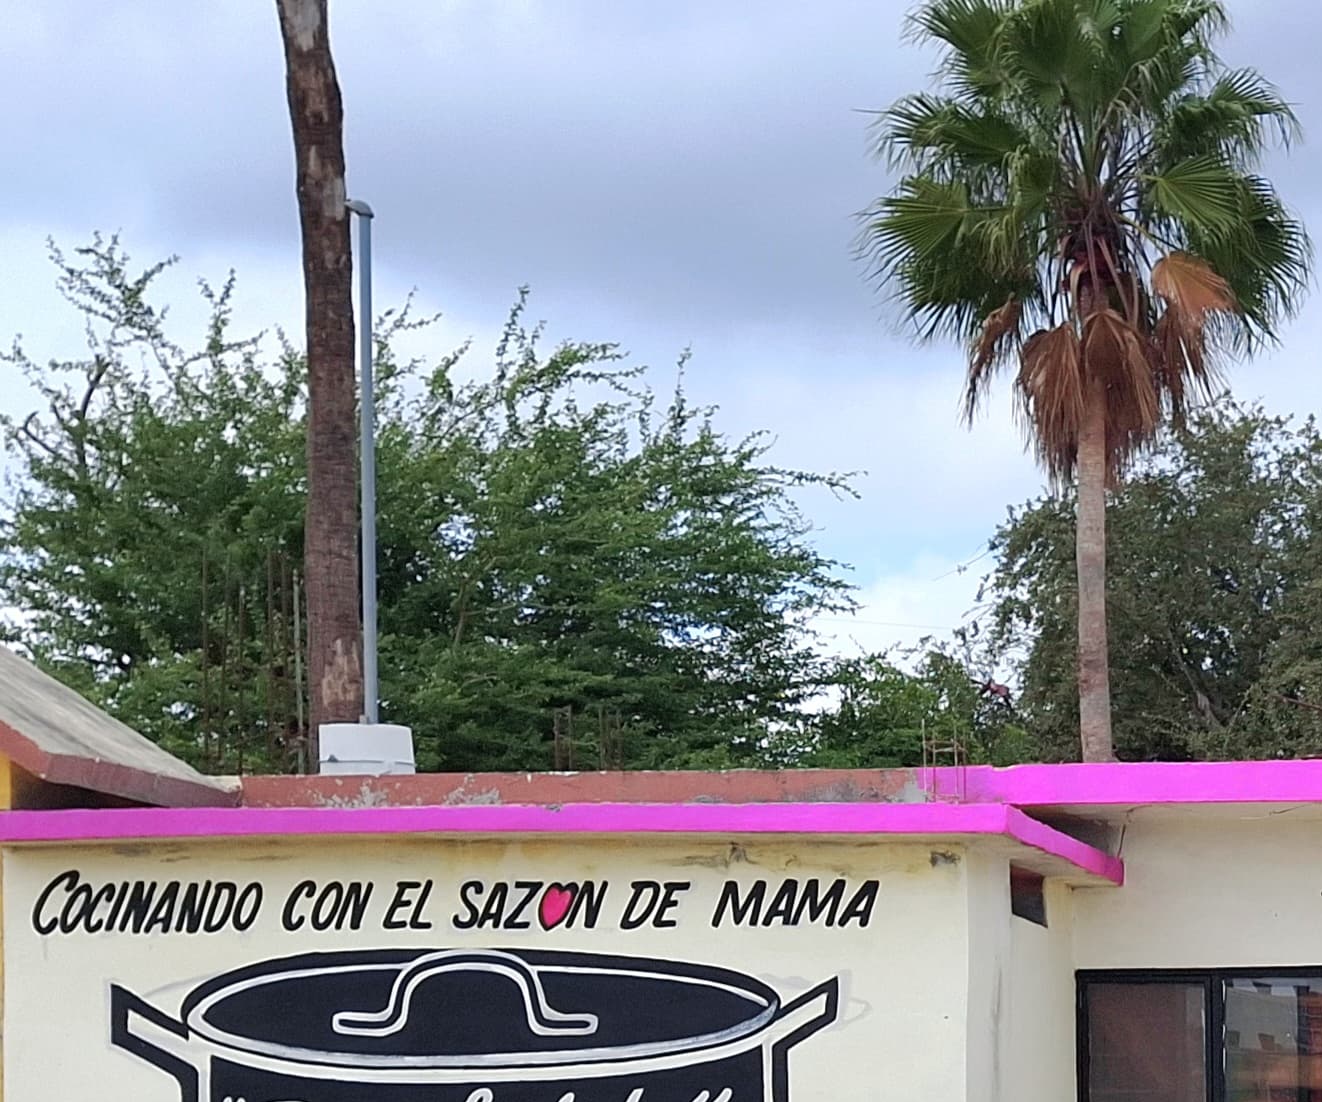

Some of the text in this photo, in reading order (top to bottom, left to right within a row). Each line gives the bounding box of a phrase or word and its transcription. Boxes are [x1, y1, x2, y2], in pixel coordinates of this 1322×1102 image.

[32, 869, 263, 936] COCINANDO
[281, 879, 374, 932] CON
[382, 880, 433, 930] EL
[619, 880, 691, 930] DE
[711, 878, 880, 930] MAMA
